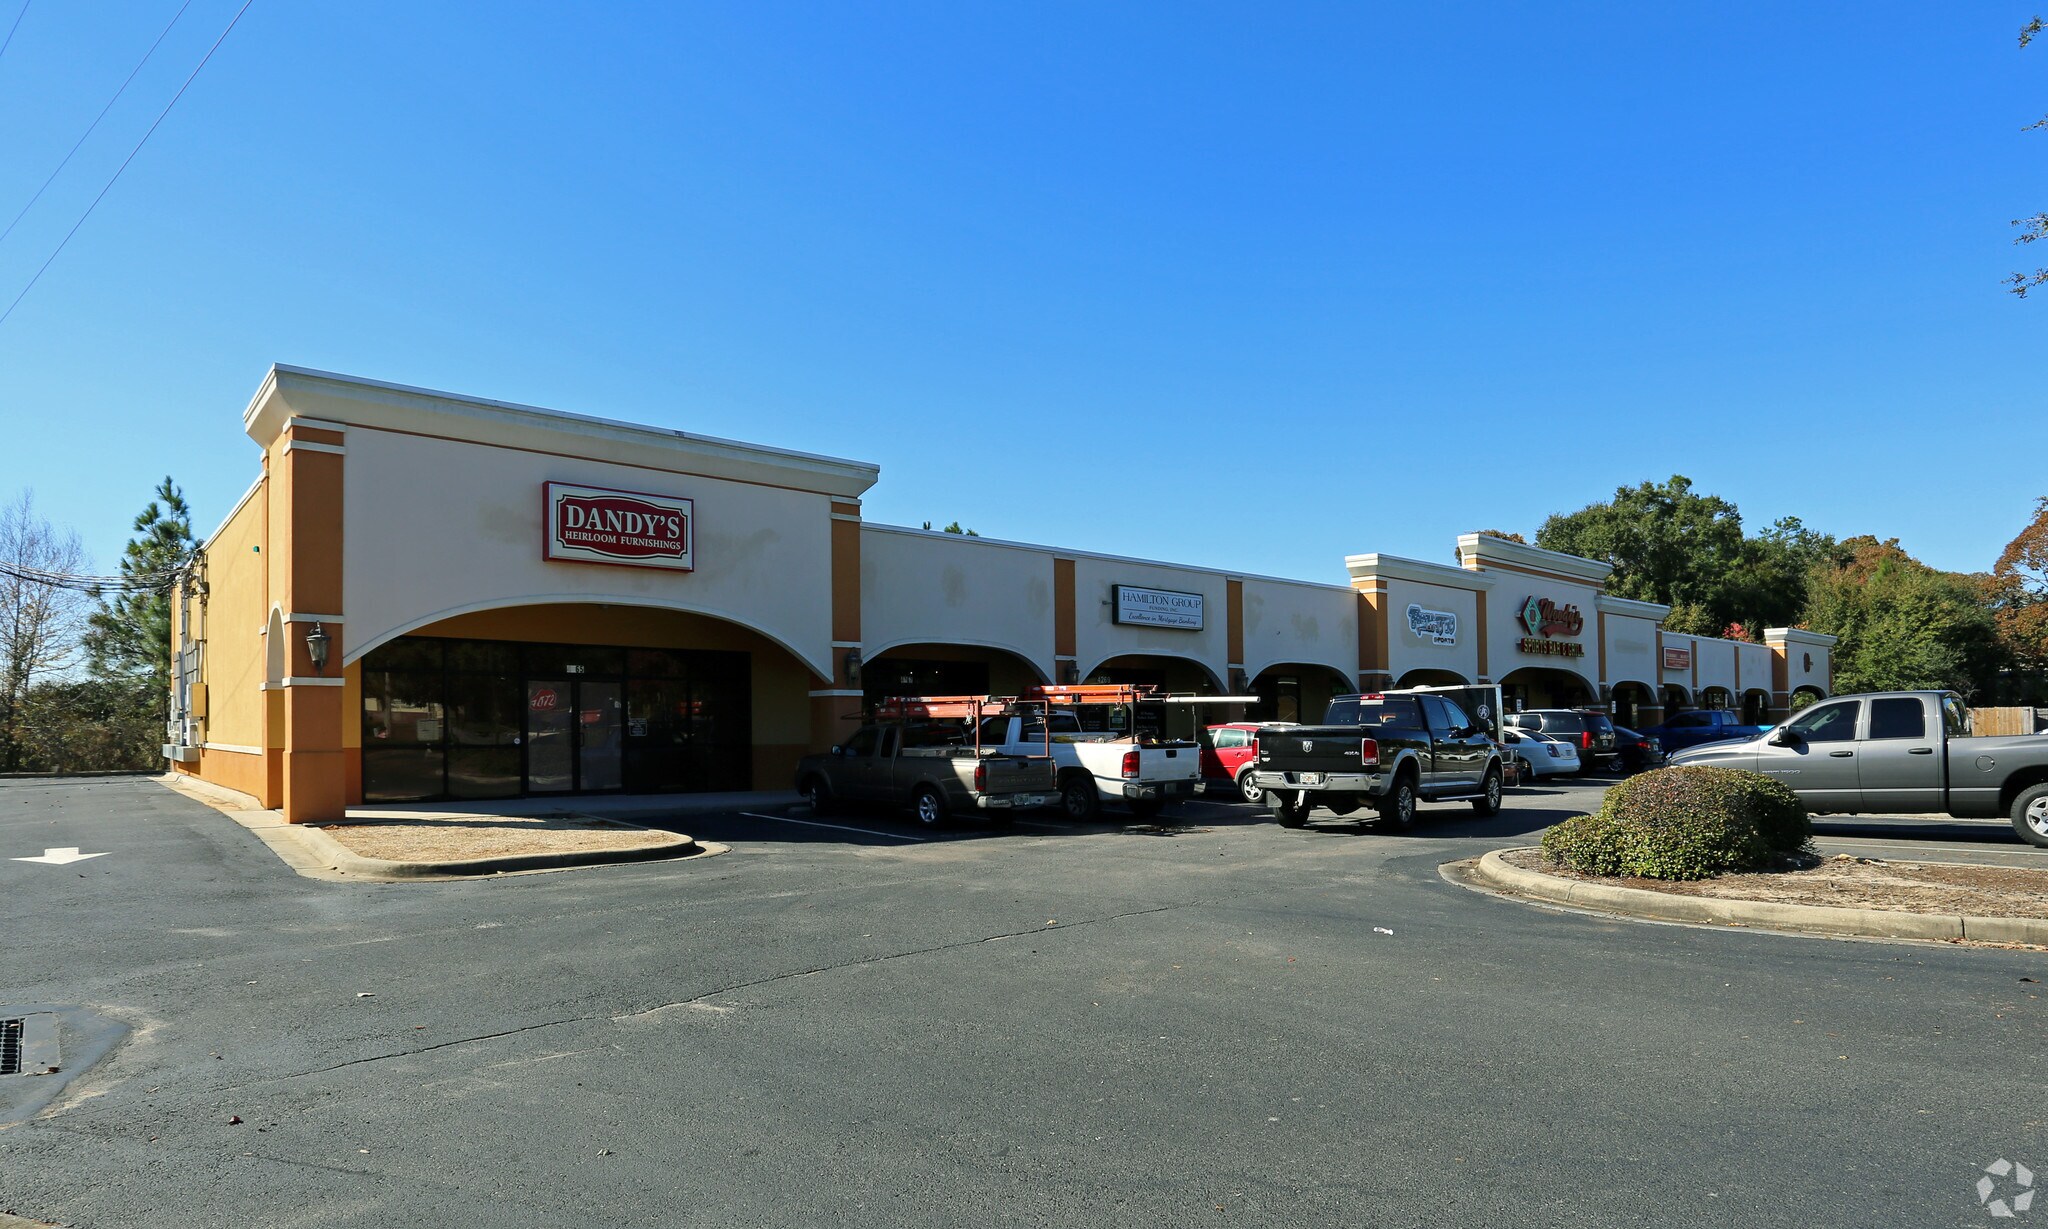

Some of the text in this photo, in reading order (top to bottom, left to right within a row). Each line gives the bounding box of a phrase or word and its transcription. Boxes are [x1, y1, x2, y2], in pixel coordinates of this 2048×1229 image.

[566, 505, 680, 539] DANDY'S
[565, 530, 681, 550] HEIRLOOM FURNISHINGS
[1122, 592, 1201, 609] HAMILTON GROUP
[1128, 612, 1150, 621] Excellence
[1158, 615, 1177, 625] Mortgage
[1178, 617, 1197, 626] Banking
[1523, 638, 1548, 654] SPORTS
[1549, 640, 1561, 656] BAR
[1568, 643, 1585, 657] GRILL
